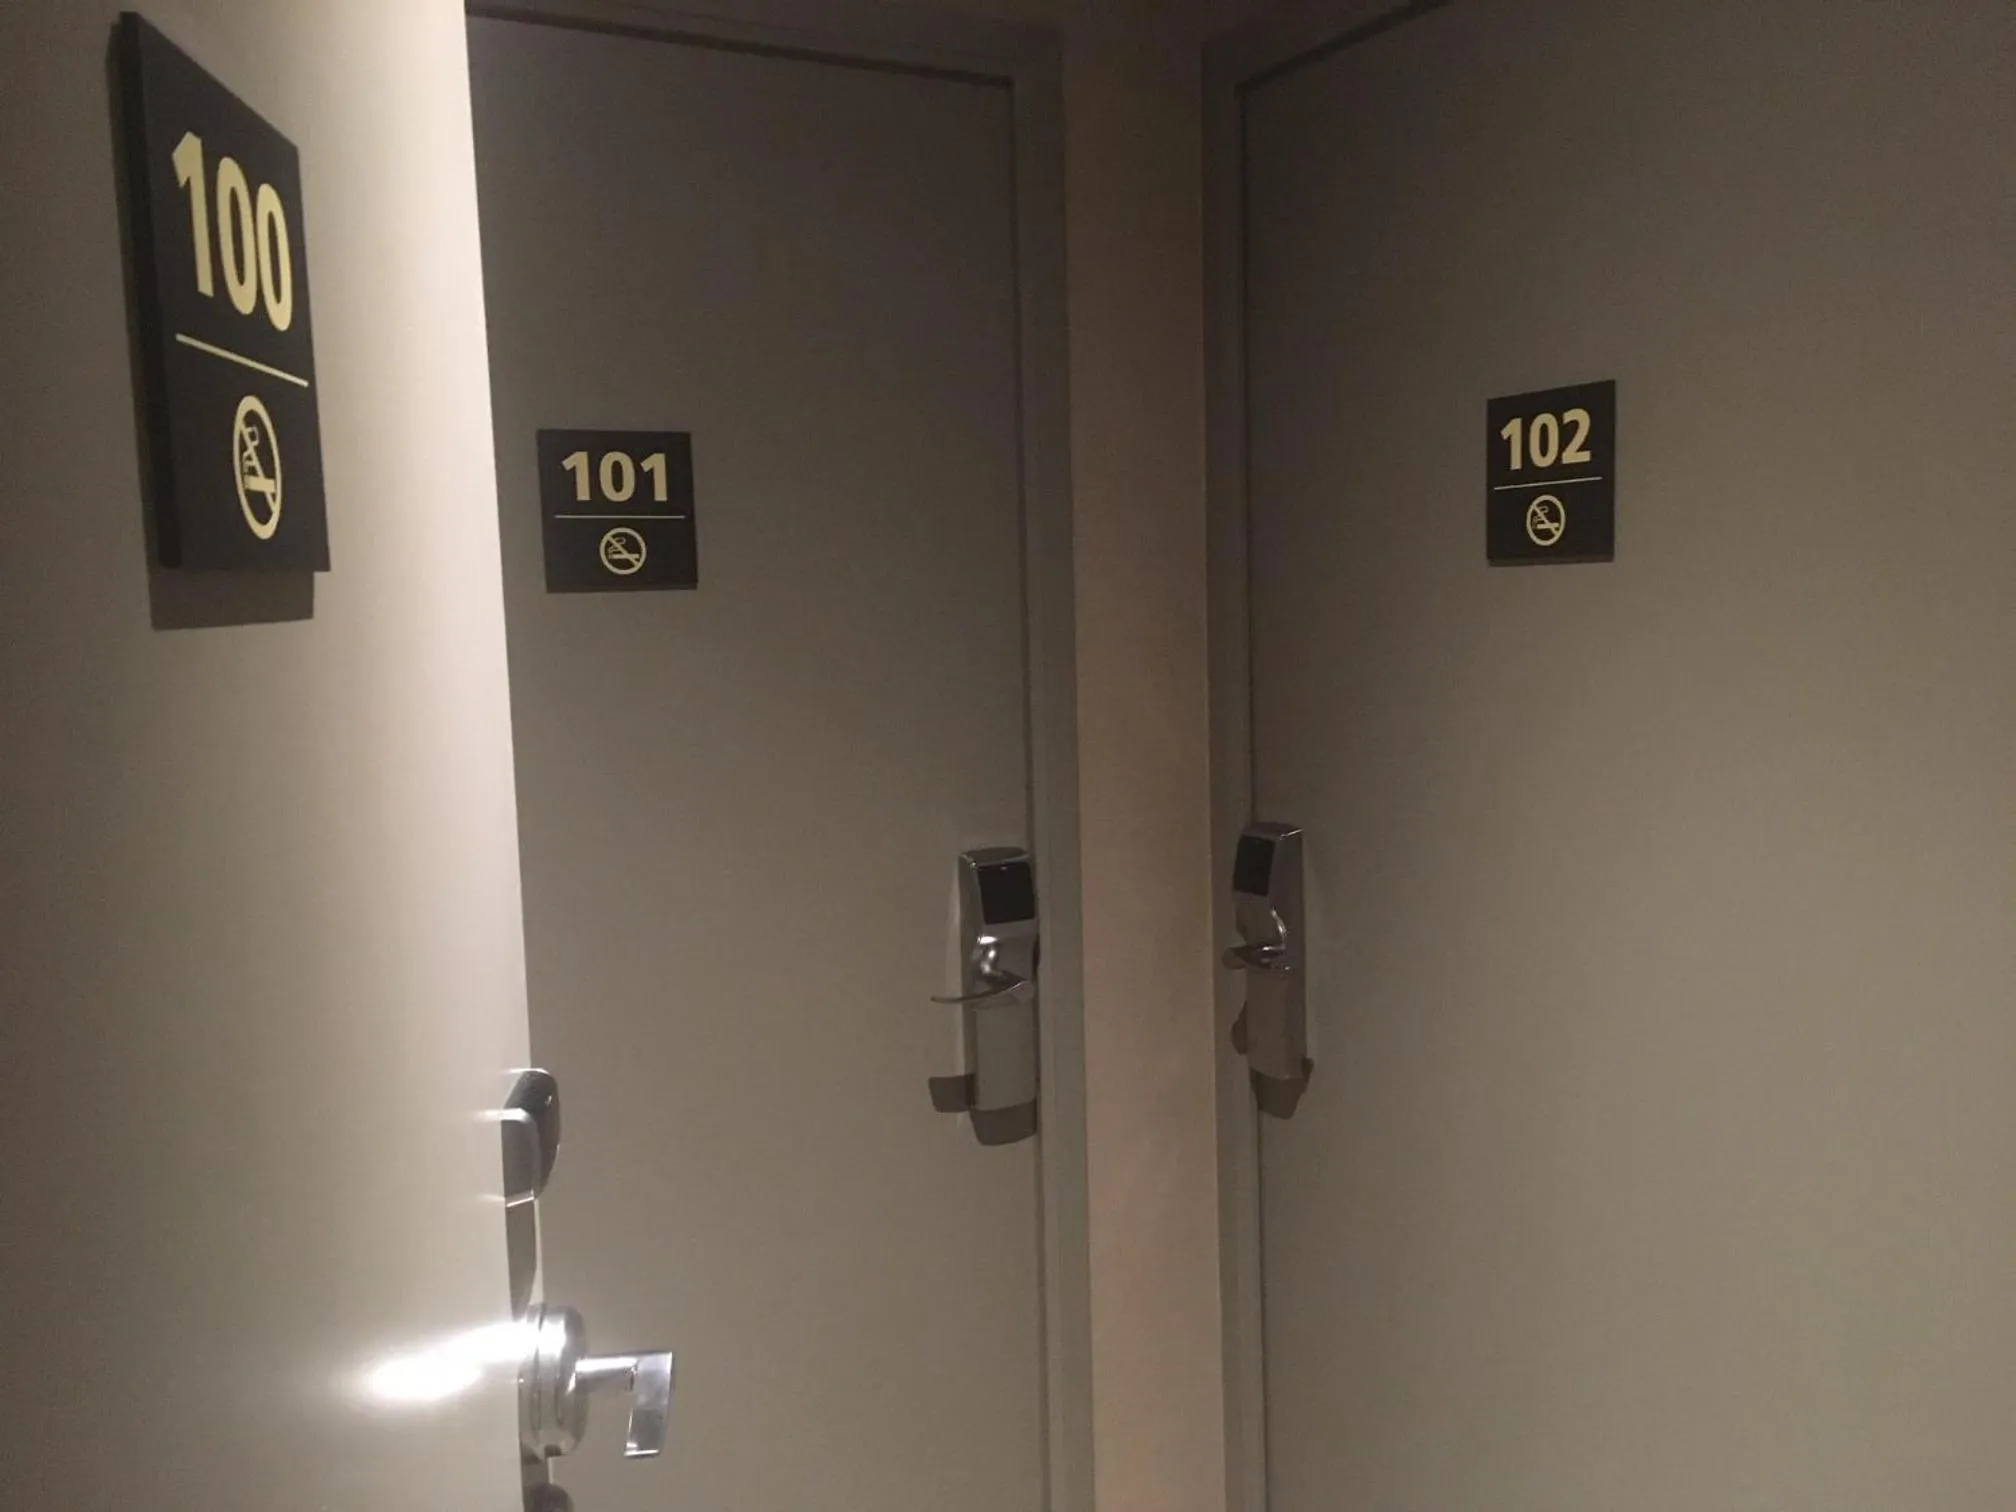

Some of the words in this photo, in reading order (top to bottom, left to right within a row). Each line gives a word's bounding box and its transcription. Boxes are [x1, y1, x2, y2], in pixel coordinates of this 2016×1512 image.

[172, 131, 293, 332] 100
[1501, 408, 1592, 470] 102
[562, 451, 668, 502] 101
